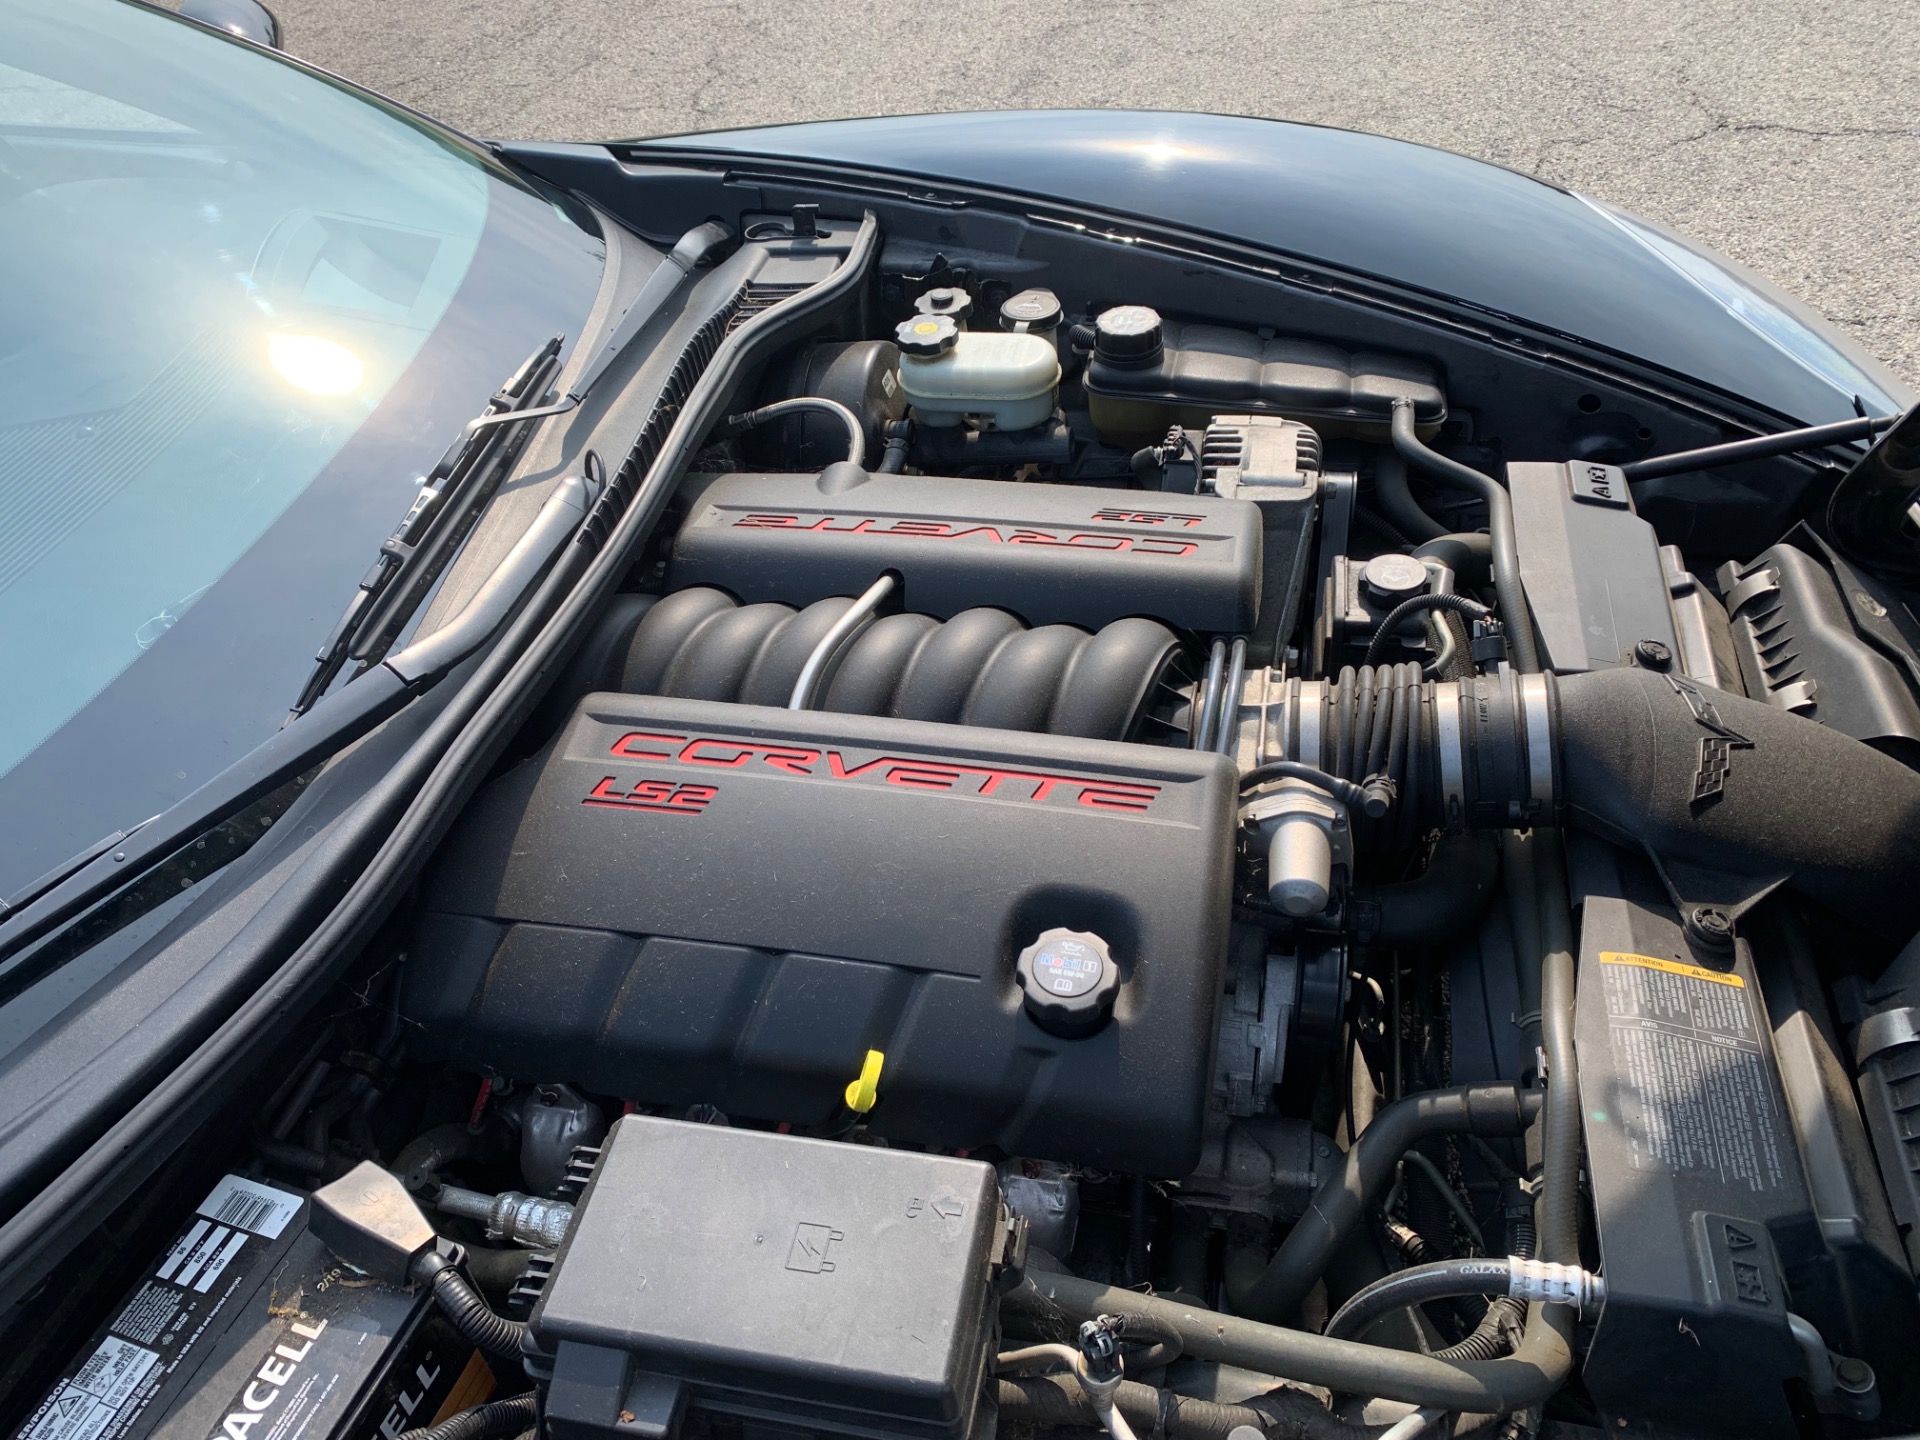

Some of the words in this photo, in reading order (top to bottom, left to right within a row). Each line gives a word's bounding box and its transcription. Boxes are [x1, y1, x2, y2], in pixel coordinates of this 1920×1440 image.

[1091, 512, 1202, 528] LS2
[732, 514, 1199, 556] CORVETTE
[610, 732, 1162, 812] CORVETTE
[589, 776, 719, 806] LS2
[1040, 953, 1081, 968] Mobil
[1625, 956, 1664, 967] ATTENTION
[1701, 971, 1732, 983] CAUTION
[1641, 1020, 1658, 1029] AVIS
[1711, 1035, 1738, 1046] NOTICE
[194, 1252, 206, 1263] 850
[212, 1258, 225, 1270] 690
[1459, 1266, 1507, 1274] GALAX
[316, 1267, 342, 1292] 2/19
[112, 1346, 133, 1368] MEDICAL
[113, 1363, 126, 1376] HELP
[83, 1375, 96, 1388] WITH
[211, 1318, 328, 1440] ACELL
[18, 1377, 70, 1439] ER/POISON
[371, 1364, 440, 1440] ELL
